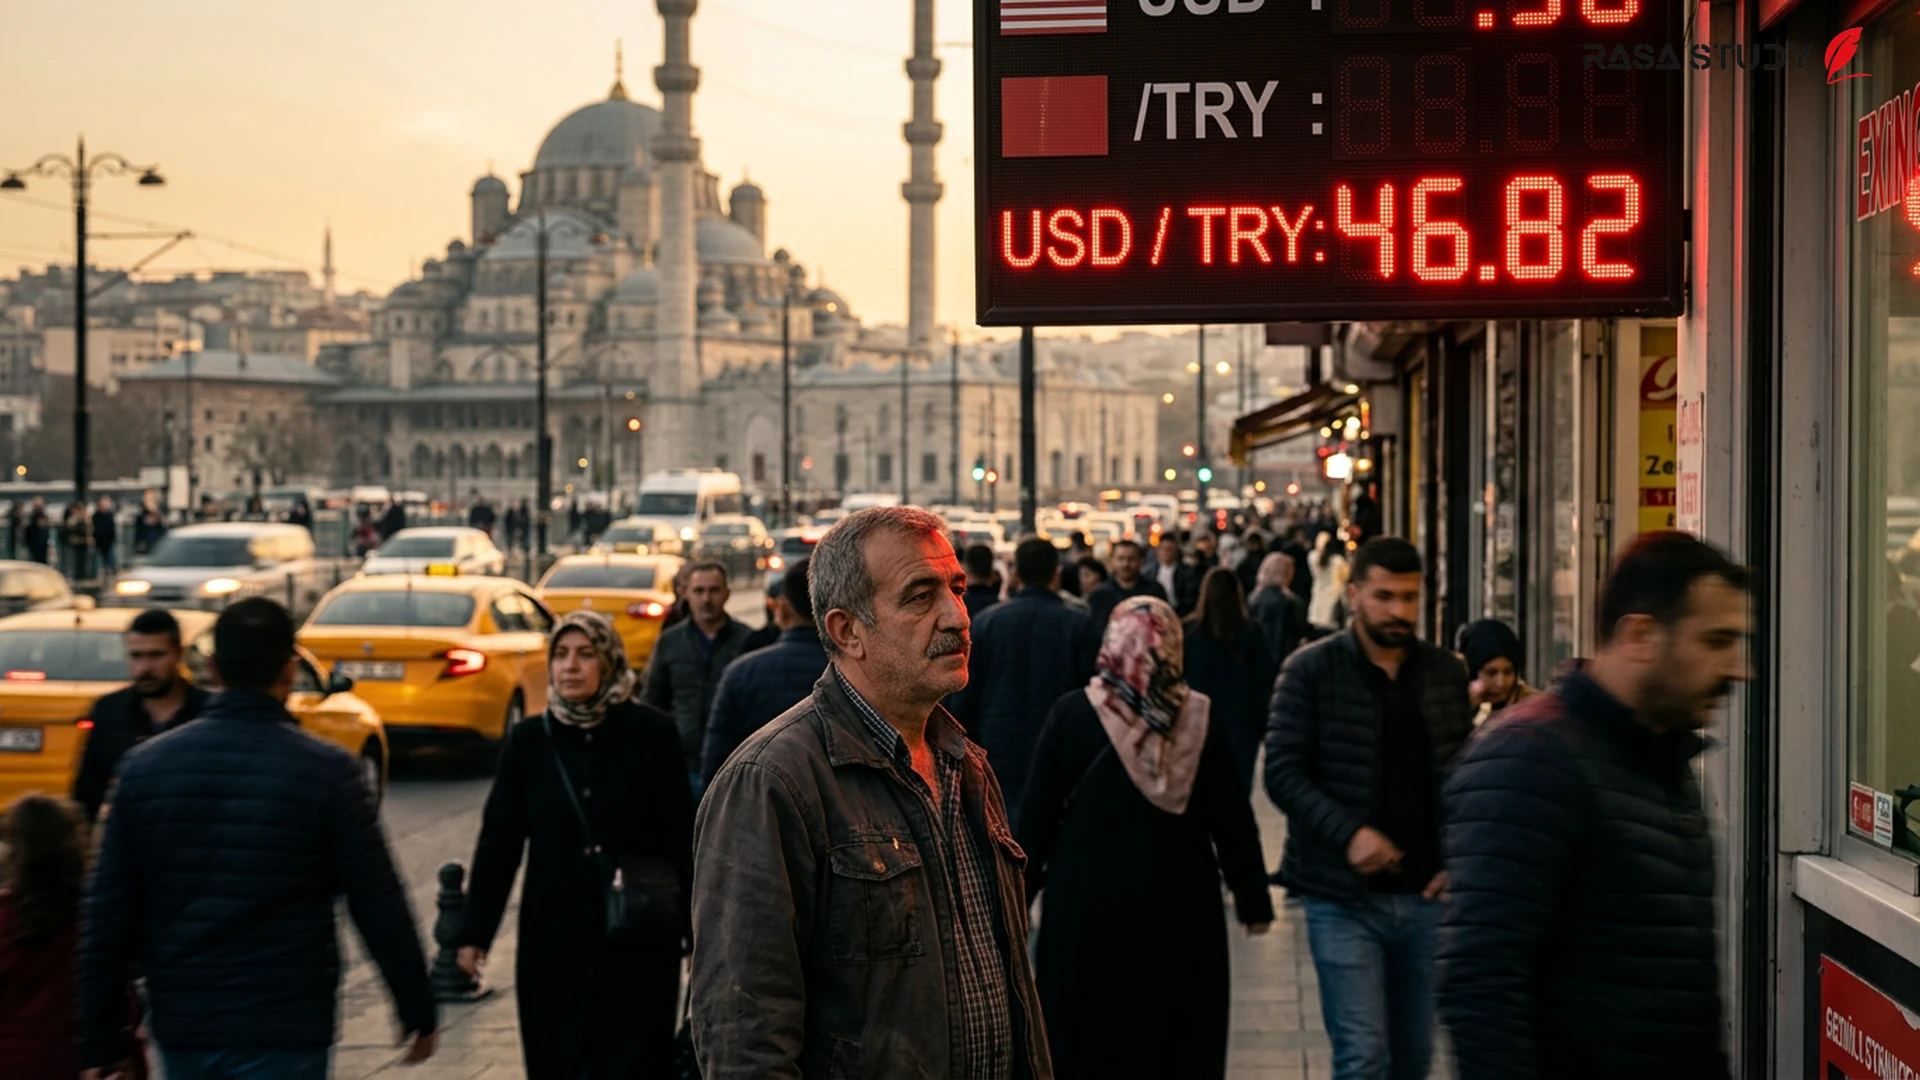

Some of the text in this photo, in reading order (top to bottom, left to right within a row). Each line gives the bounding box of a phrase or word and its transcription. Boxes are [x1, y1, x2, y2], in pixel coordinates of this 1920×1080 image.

[1133, 80, 1279, 141] /TRY
[1002, 208, 1132, 267] USD
[1337, 174, 1640, 281] 46.82
